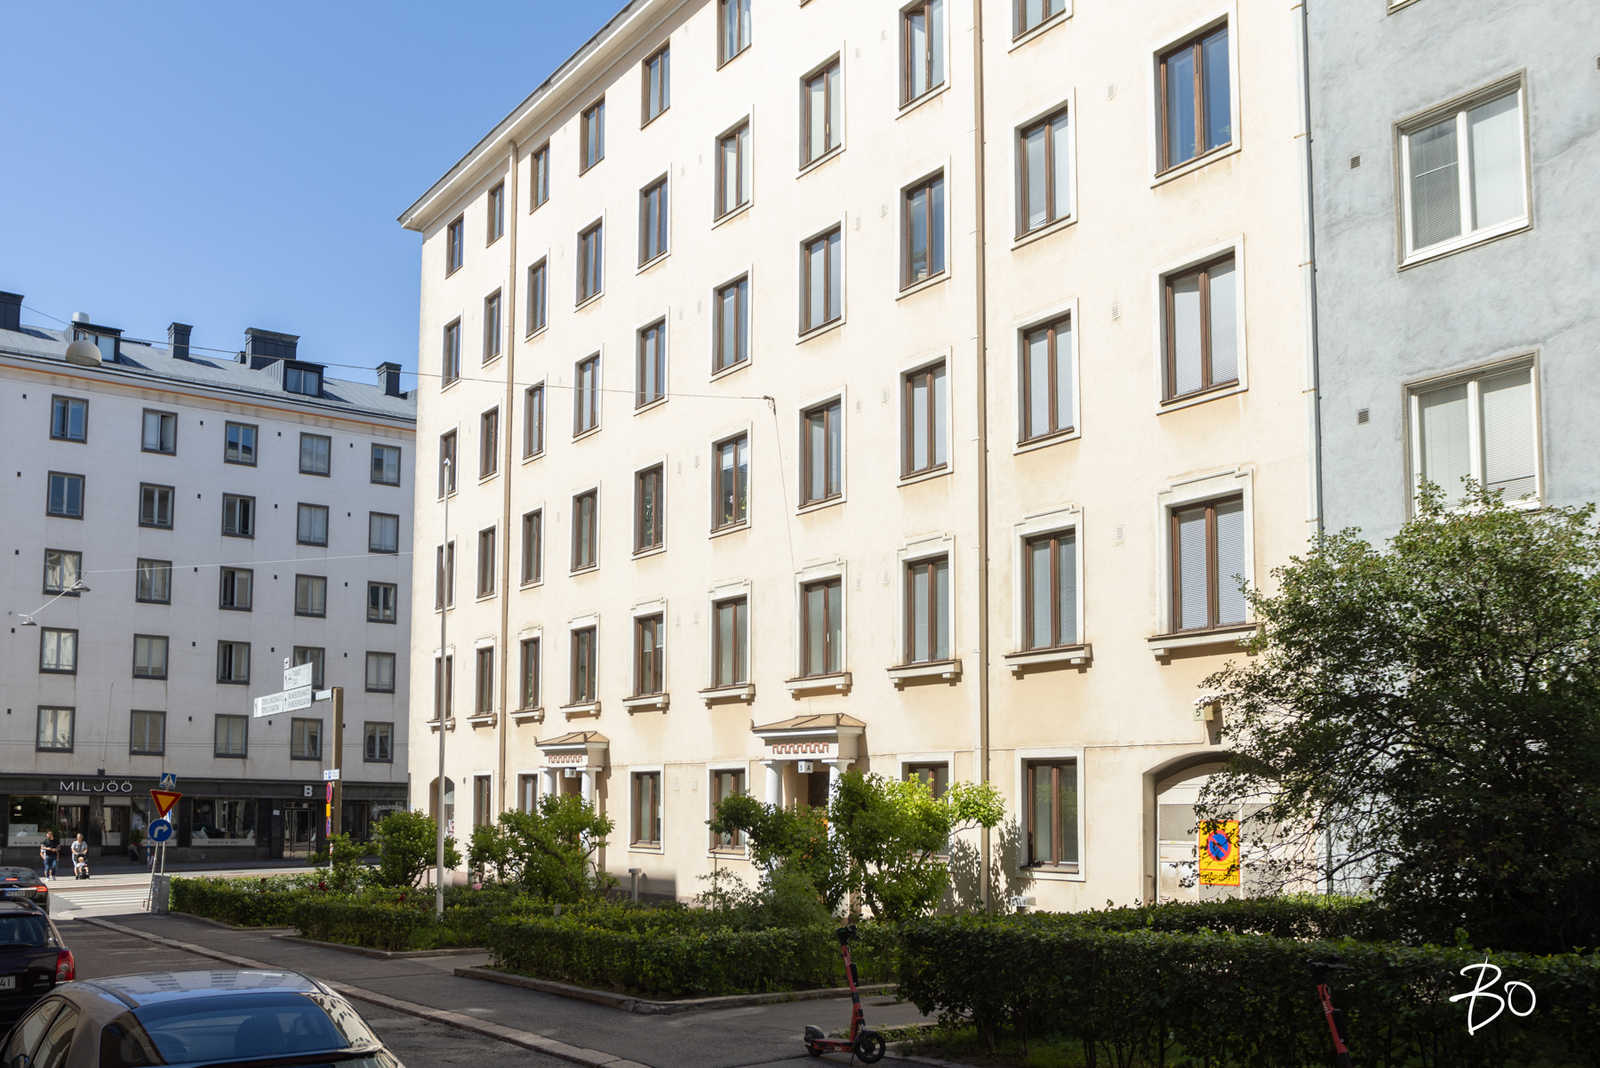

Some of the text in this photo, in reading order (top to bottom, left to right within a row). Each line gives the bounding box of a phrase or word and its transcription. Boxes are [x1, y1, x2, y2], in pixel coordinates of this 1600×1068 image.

[1196, 708, 1201, 717] 5
[59, 780, 133, 792] MILJÖÖ
[303, 785, 313, 797] B
